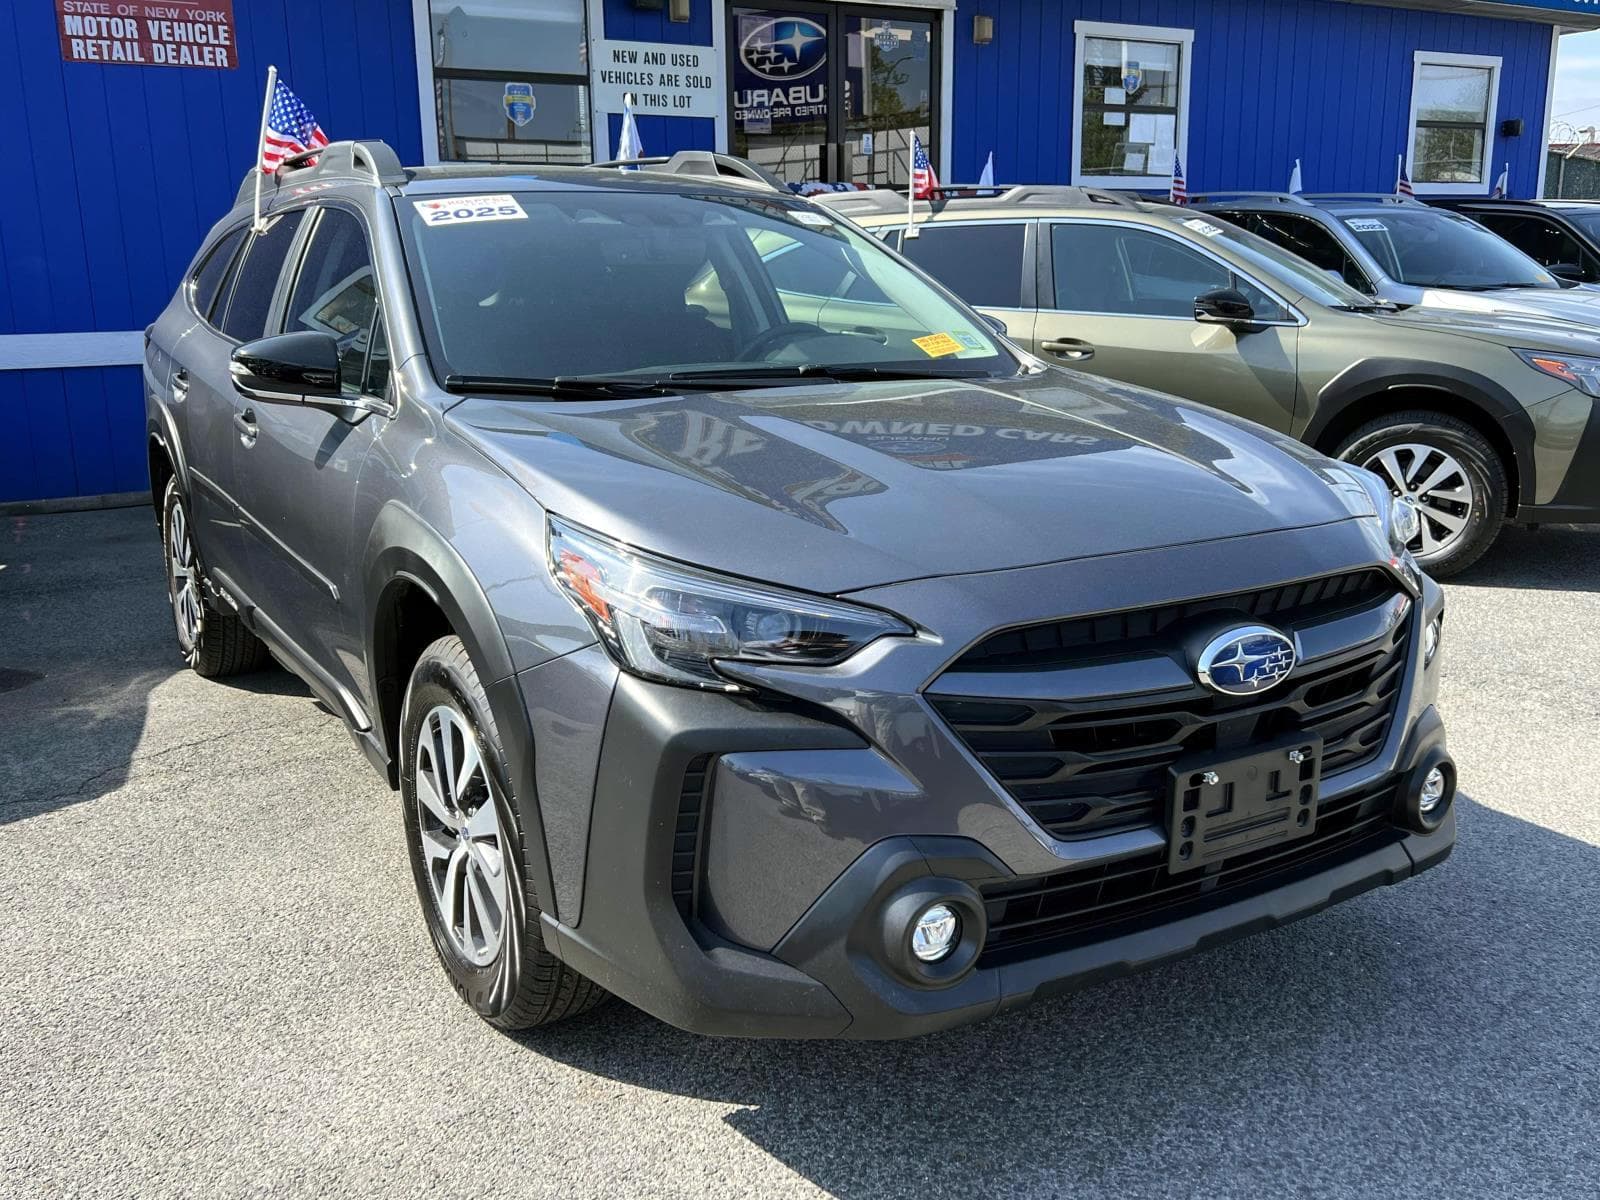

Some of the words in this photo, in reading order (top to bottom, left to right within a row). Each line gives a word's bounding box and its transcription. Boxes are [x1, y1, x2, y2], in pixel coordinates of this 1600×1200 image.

[63, 1, 112, 15] STATE
[116, 4, 138, 16] OF
[145, 6, 180, 19] NEW
[185, 8, 228, 23] YORK
[63, 15, 139, 39] MOTOR
[147, 19, 231, 46] VEHICLE
[71, 38, 145, 62] RETAIL
[152, 43, 229, 68] DEALER
[613, 49, 638, 64] NEW
[643, 51, 666, 66] AND
[671, 53, 699, 68] USED
[600, 70, 654, 86] VEHICLES
[659, 74, 680, 87] ARE
[685, 75, 712, 89] SOLD
[642, 93, 668, 107] THIS
[673, 95, 692, 109] LOT
[430, 206, 518, 221] 2025
